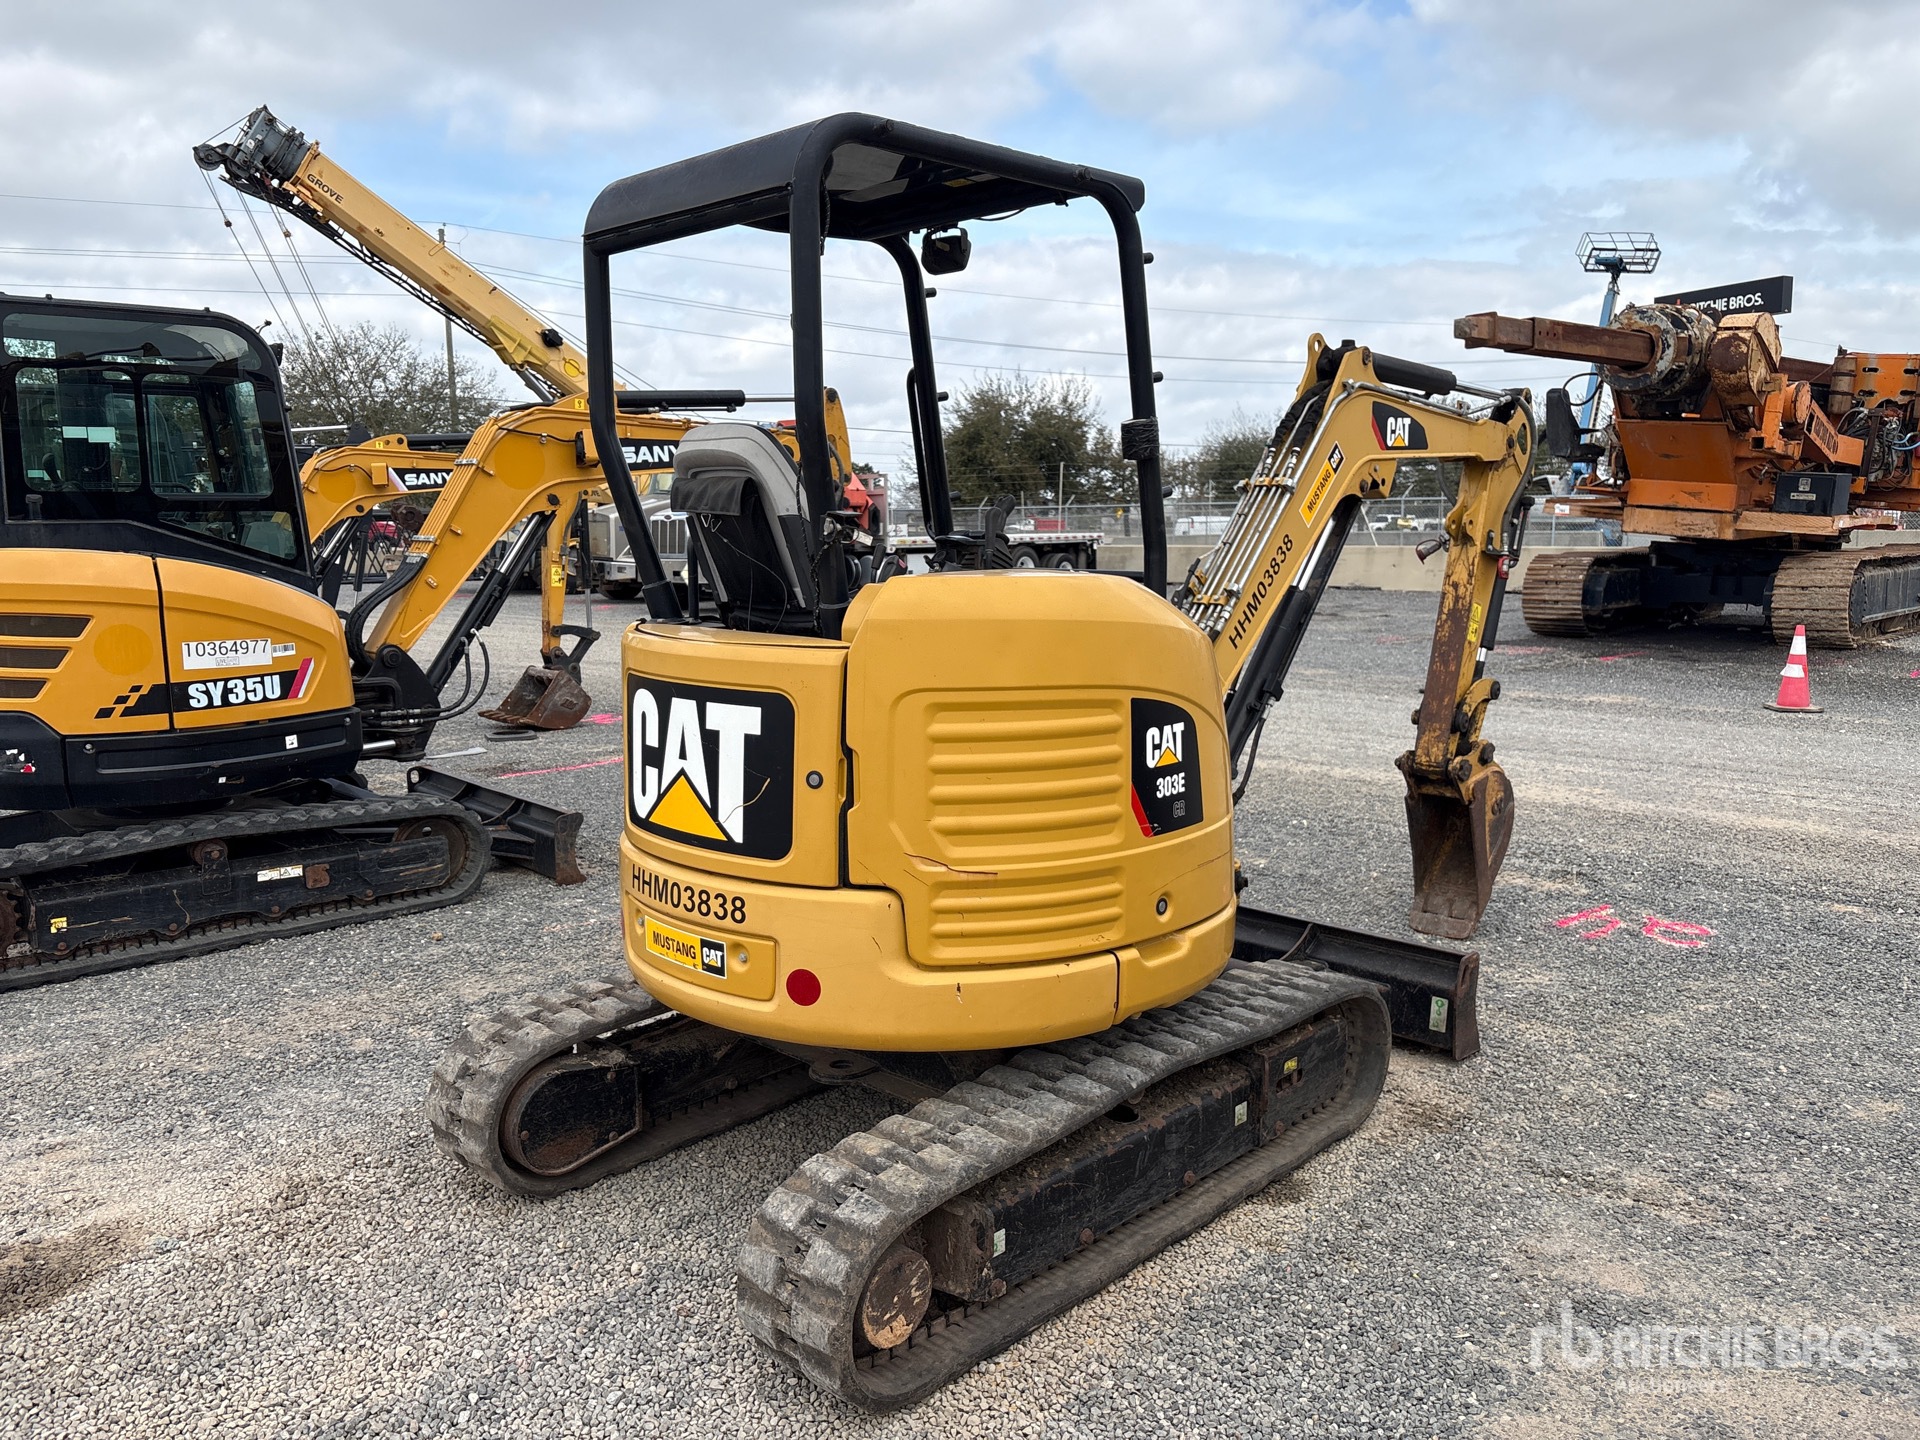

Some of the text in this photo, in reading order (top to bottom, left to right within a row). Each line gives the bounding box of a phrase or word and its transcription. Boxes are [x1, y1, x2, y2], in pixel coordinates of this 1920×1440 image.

[307, 173, 344, 204] GROVE
[1729, 292, 1764, 310] BROS.
[1386, 416, 1411, 447] CAT
[1306, 448, 1341, 514] MUSTANG CAT
[1228, 533, 1294, 649] HHM03838
[183, 639, 269, 658] 10364977
[187, 674, 281, 708] SY35U
[1145, 721, 1185, 769] CAT
[632, 688, 762, 844] CAT
[1156, 771, 1185, 799] 303E
[1172, 800, 1186, 818] CR
[631, 863, 747, 924] HHM03838
[652, 930, 723, 968] MUSTANG CAT
